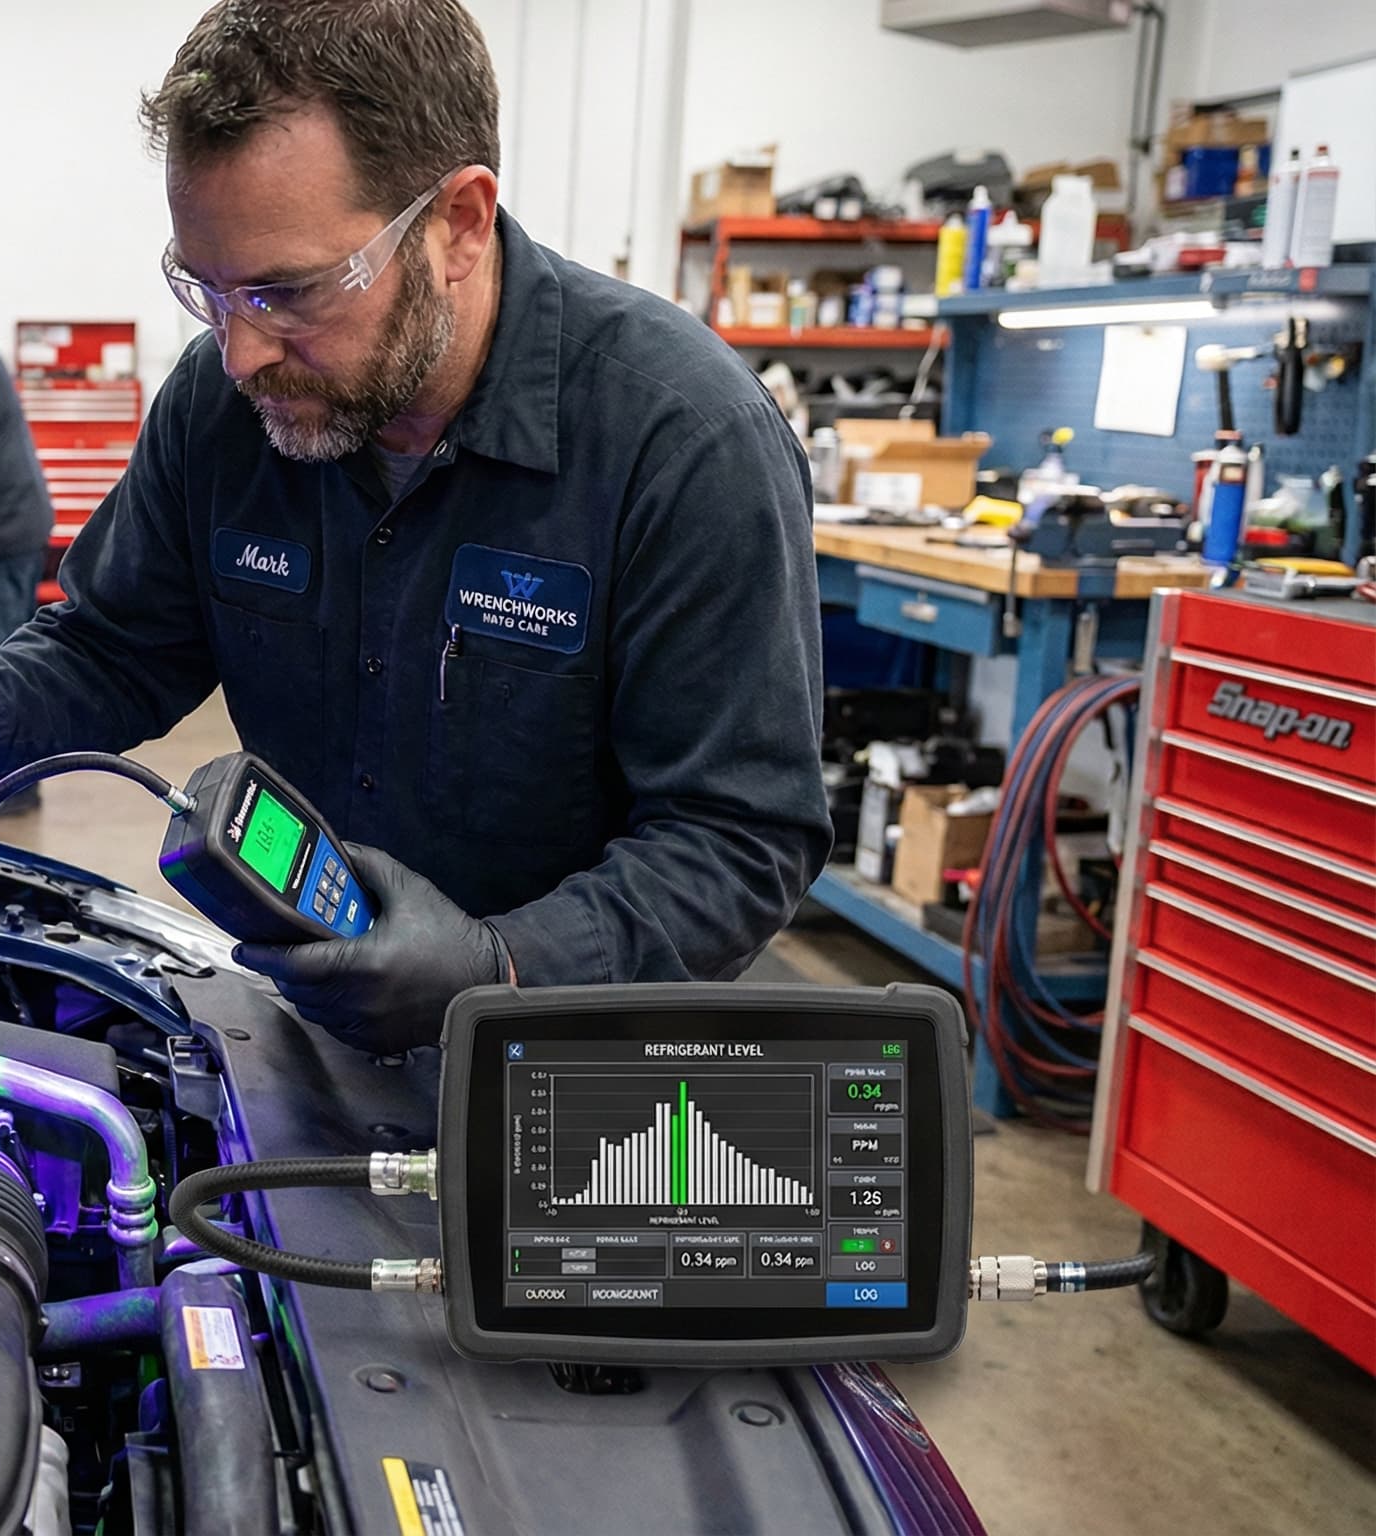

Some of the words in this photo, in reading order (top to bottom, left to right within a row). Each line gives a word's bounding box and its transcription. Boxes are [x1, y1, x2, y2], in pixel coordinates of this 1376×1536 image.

[236, 543, 290, 577] Mark
[459, 589, 577, 627] WRENCHWORKS
[1207, 680, 1351, 748] Snap-on
[644, 1043, 725, 1057] REFRIGERANT
[727, 1043, 764, 1057] LEVEL
[847, 1083, 882, 1100] 0.34
[681, 1252, 713, 1267] 0.34
[761, 1252, 792, 1267] 0.34
[854, 1287, 879, 1301] LOG
